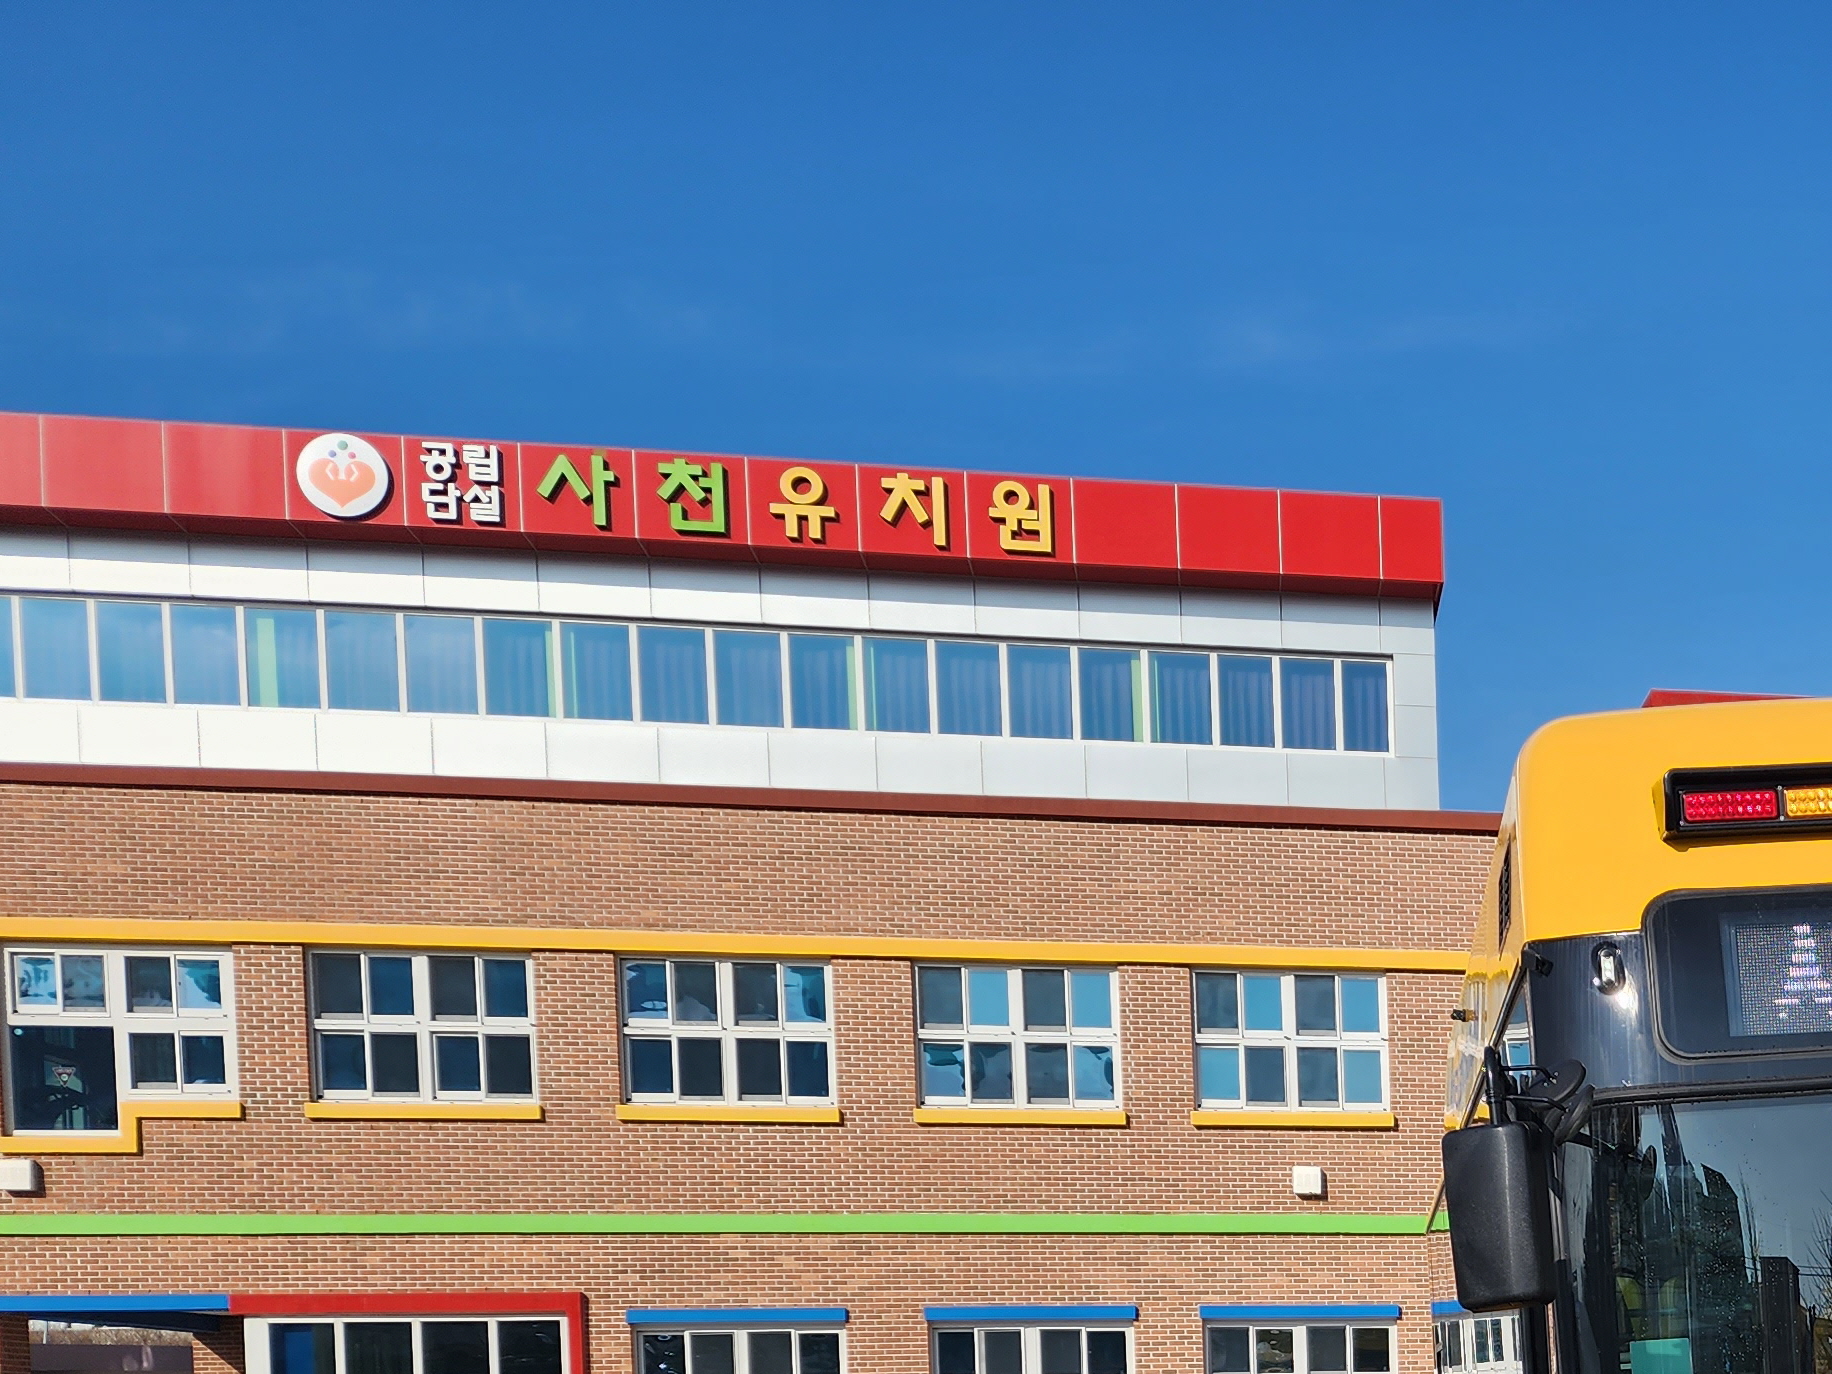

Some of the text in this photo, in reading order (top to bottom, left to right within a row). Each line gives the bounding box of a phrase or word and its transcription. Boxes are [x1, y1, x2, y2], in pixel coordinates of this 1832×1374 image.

[419, 440, 501, 483] 공립
[420, 481, 502, 523] 단설
[536, 453, 1055, 553] 사천유치원
